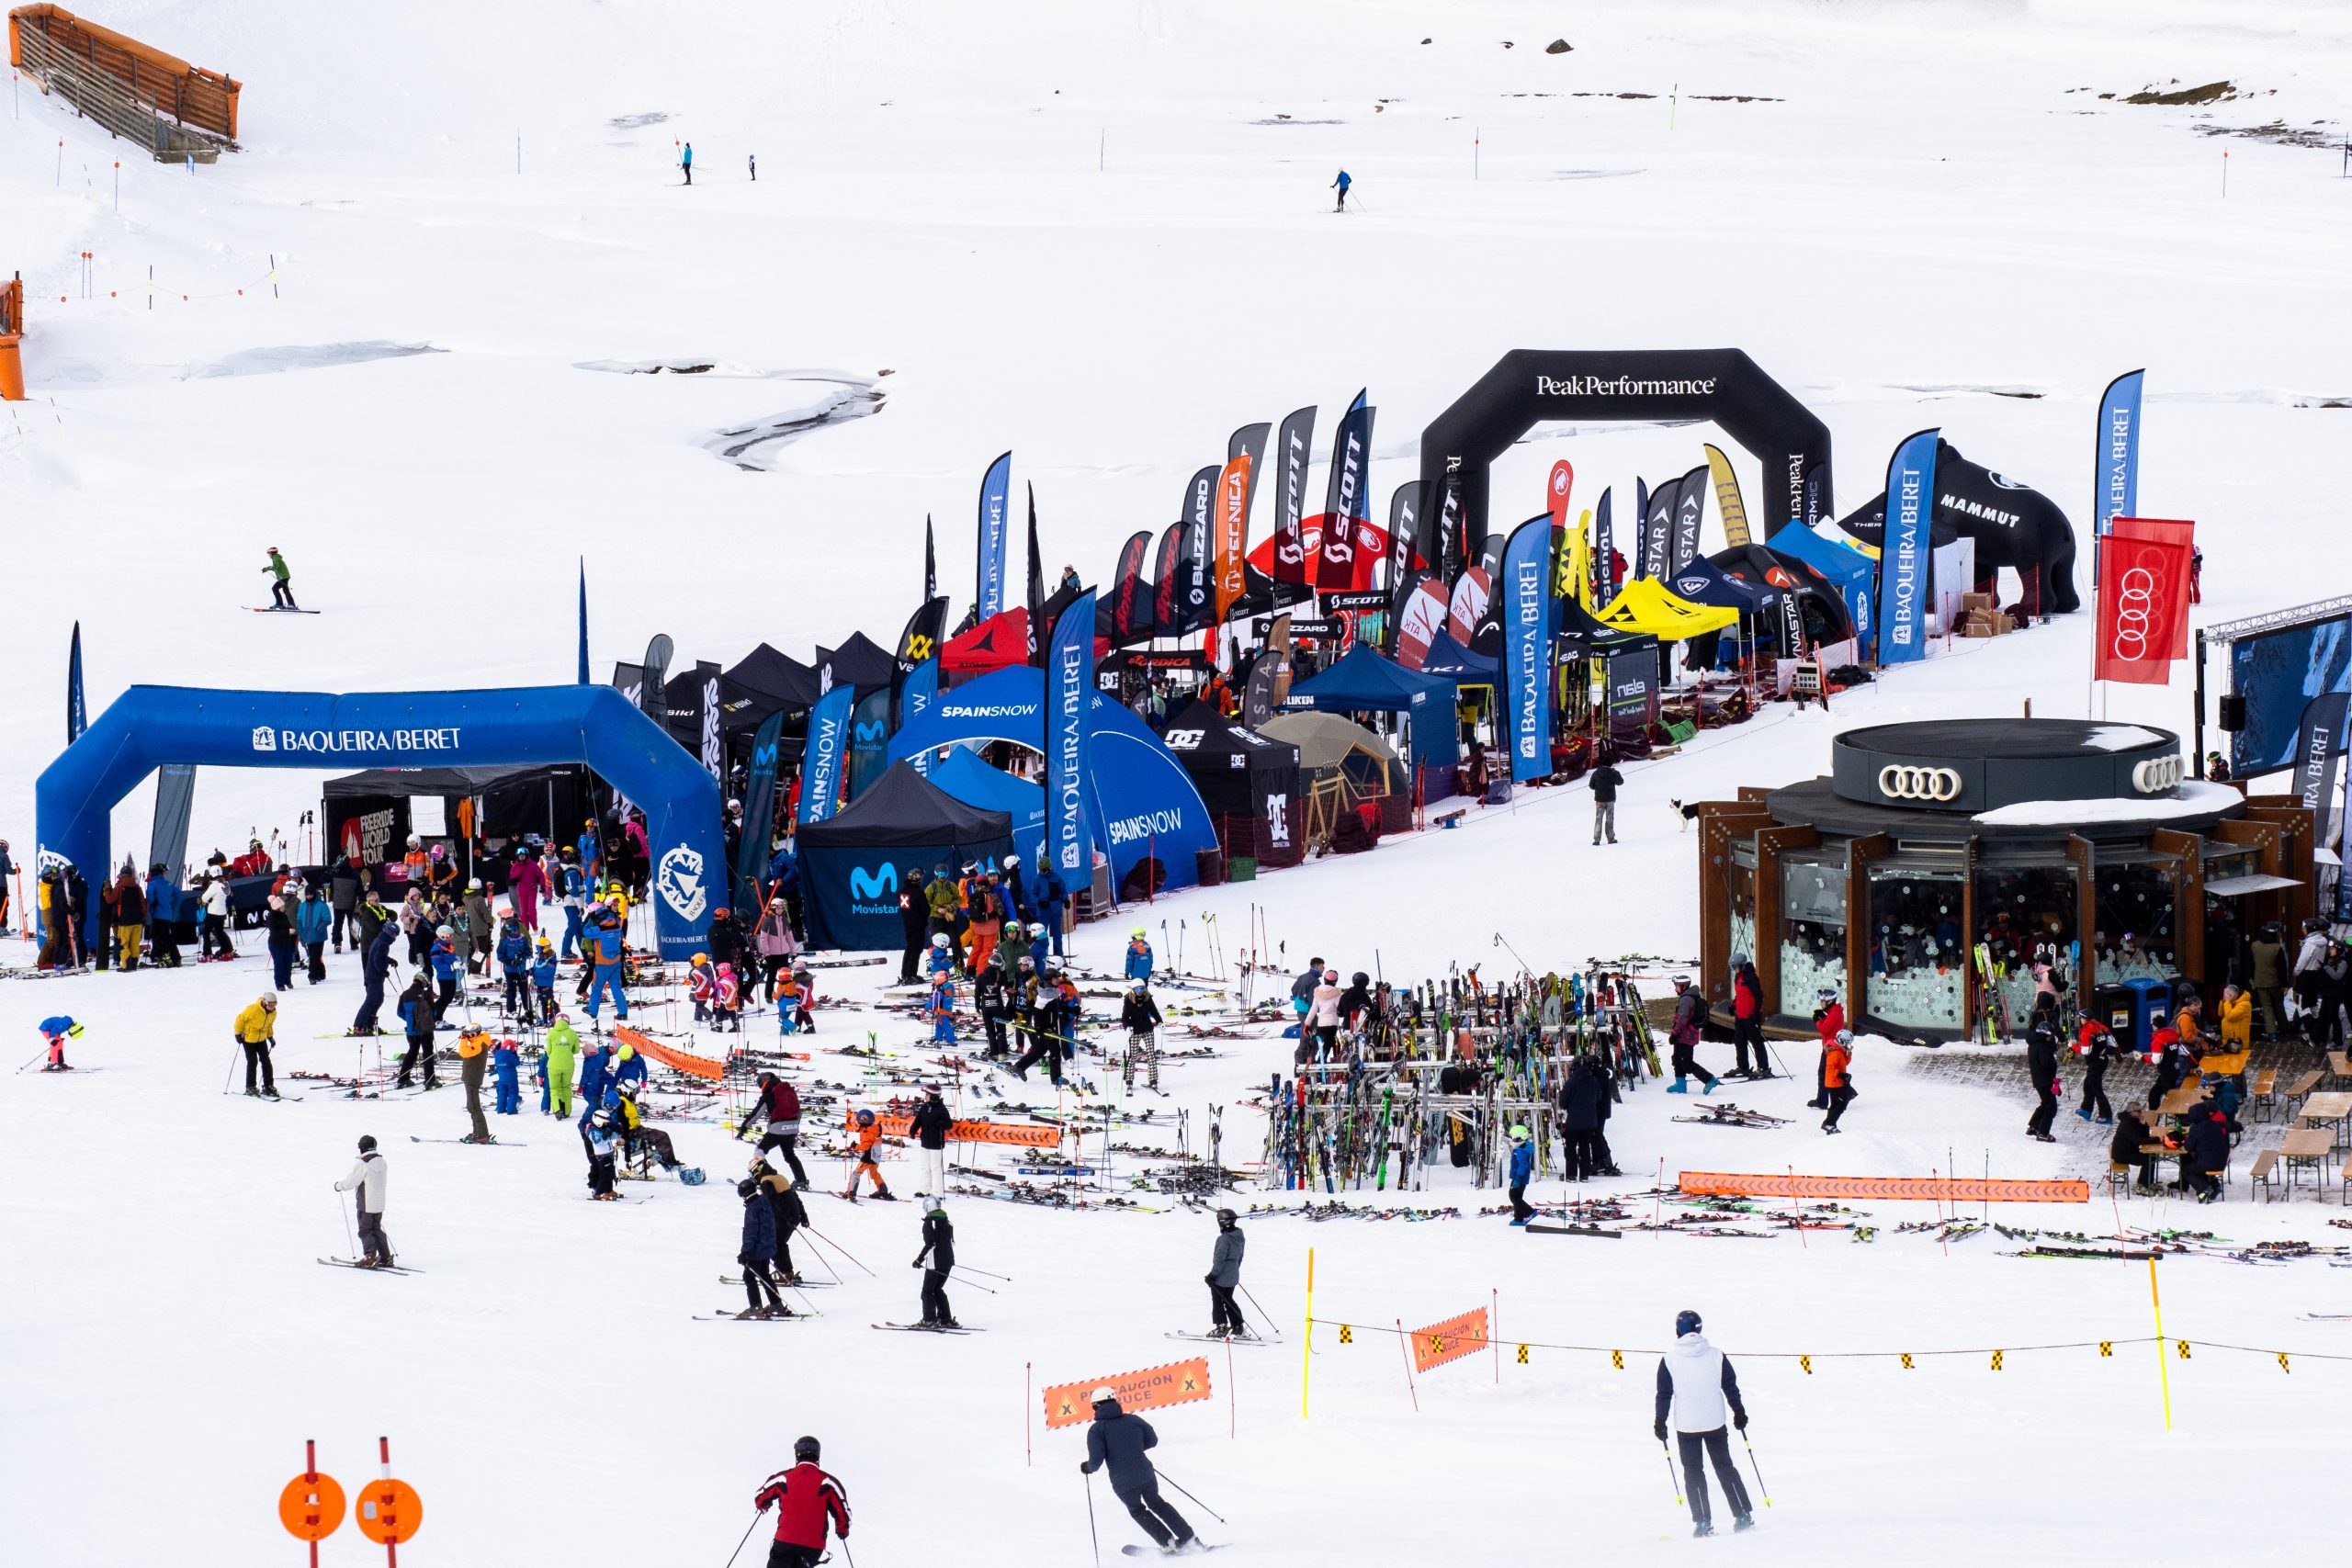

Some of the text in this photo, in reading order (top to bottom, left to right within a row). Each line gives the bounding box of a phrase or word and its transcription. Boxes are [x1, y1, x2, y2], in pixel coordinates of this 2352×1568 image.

[1228, 471, 1241, 565] TECNICA
[1287, 429, 1303, 541] SCOTT
[1335, 431, 1361, 541] SCOTT
[1939, 493, 2020, 528] MAMMUT
[1192, 479, 1209, 586] BLIZZARD
[1393, 501, 1414, 594] COTT
[1895, 467, 1920, 622] BAQUEIRA/BERET
[1519, 560, 1539, 732] BAQUEIRA/BERET
[1782, 593, 1802, 659] YNASTAR
[282, 728, 461, 753] BAQUEIRA/BERET
[941, 704, 1037, 717] SPAINSNOW
[1063, 645, 1080, 840] BAQUEIRA/BERET
[165, 768, 192, 776] Movista
[809, 718, 837, 823] PAINSNOW
[2303, 724, 2329, 808] IRA/BERET
[360, 808, 395, 832] FREERIDE
[362, 828, 390, 851] WORLD
[1109, 807, 1182, 845] SPAINSNOW
[363, 846, 385, 866] TOUR
[852, 904, 900, 914] Movistar
[1117, 1390, 1152, 1405] RUCE
